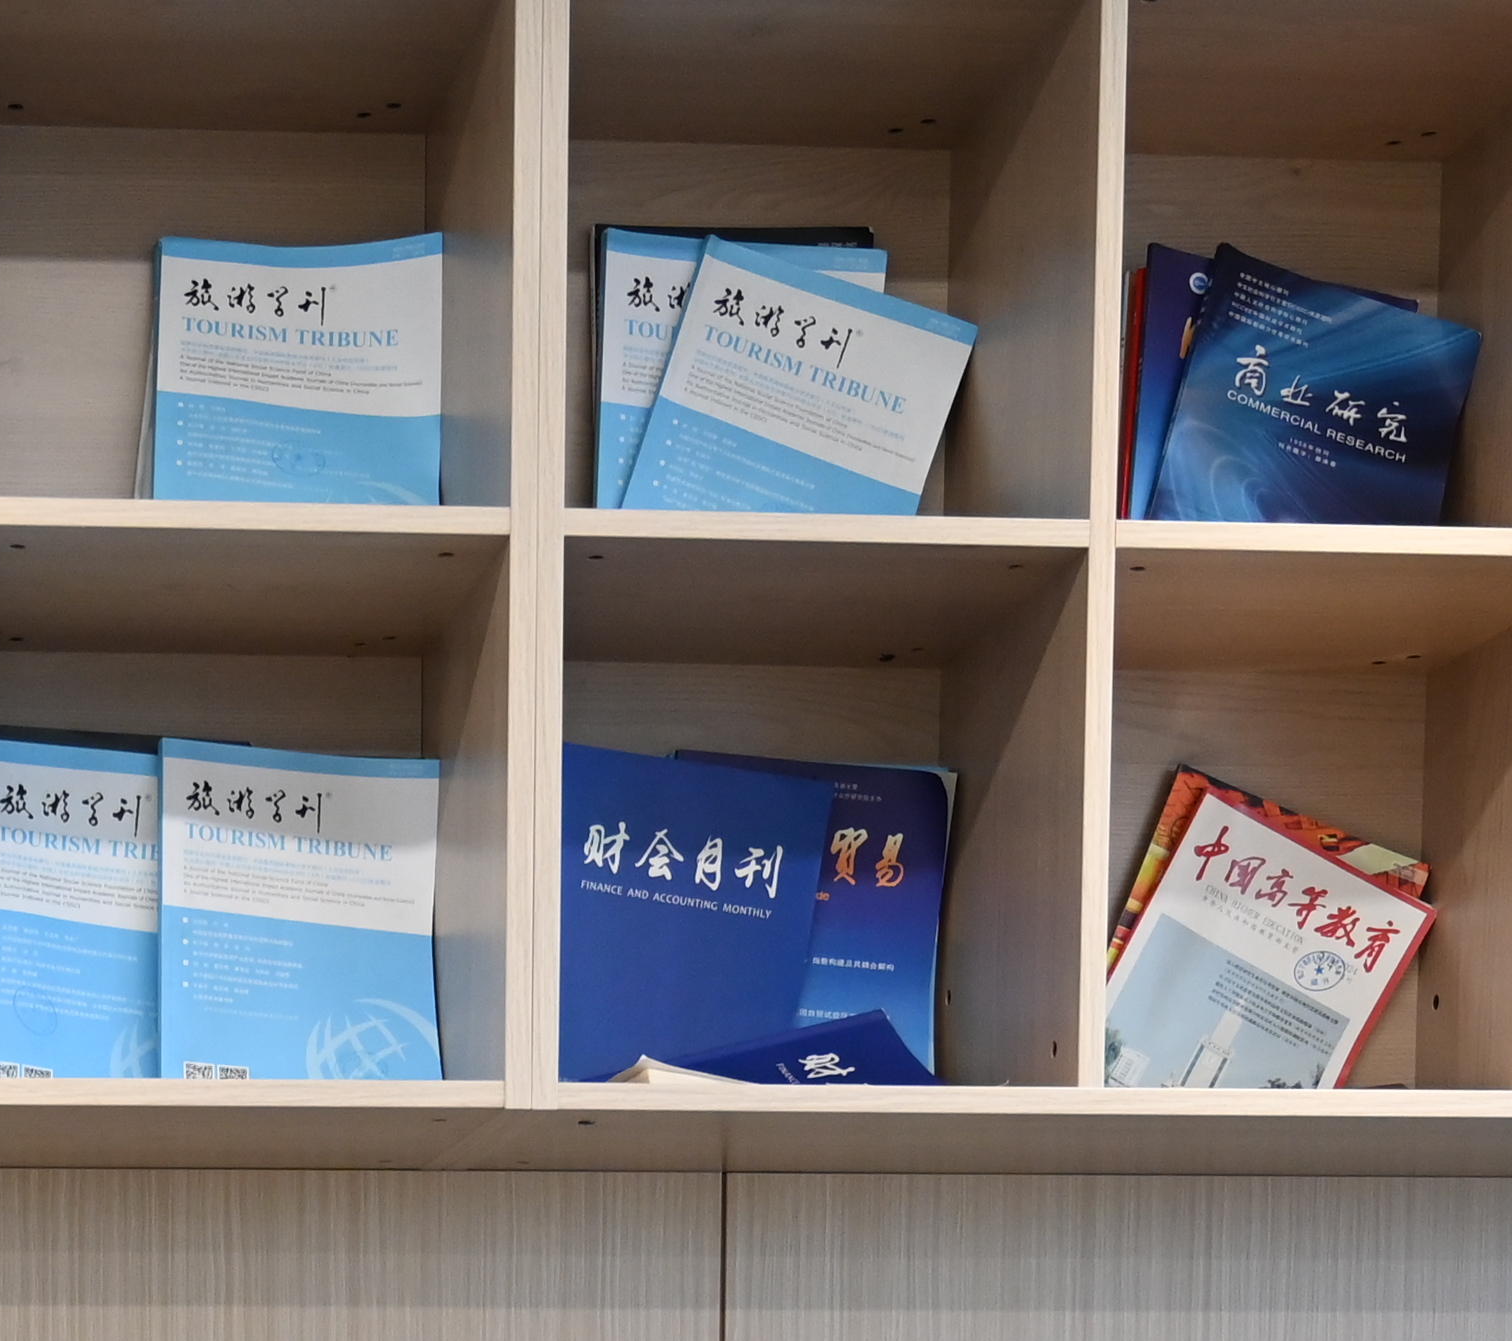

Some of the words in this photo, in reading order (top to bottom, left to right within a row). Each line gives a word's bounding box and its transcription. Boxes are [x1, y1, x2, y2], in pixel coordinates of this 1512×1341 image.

[181, 316, 288, 343] TOURISM
[295, 329, 399, 348] TRIBUNE
[704, 324, 802, 377] TOURISM
[809, 364, 907, 415] TRIBUNE
[1226, 389, 1322, 436] COMMERCIAL
[1326, 428, 1407, 464] RESEARCH
[184, 821, 288, 852] TOURISM
[293, 835, 393, 863] TRIBUNE
[583, 821, 784, 899] 财会月刊
[580, 879, 623, 896] FINANCE
[627, 886, 649, 900] AND
[652, 891, 718, 912] ACCOUNTING
[722, 902, 773, 920] MONTHLY
